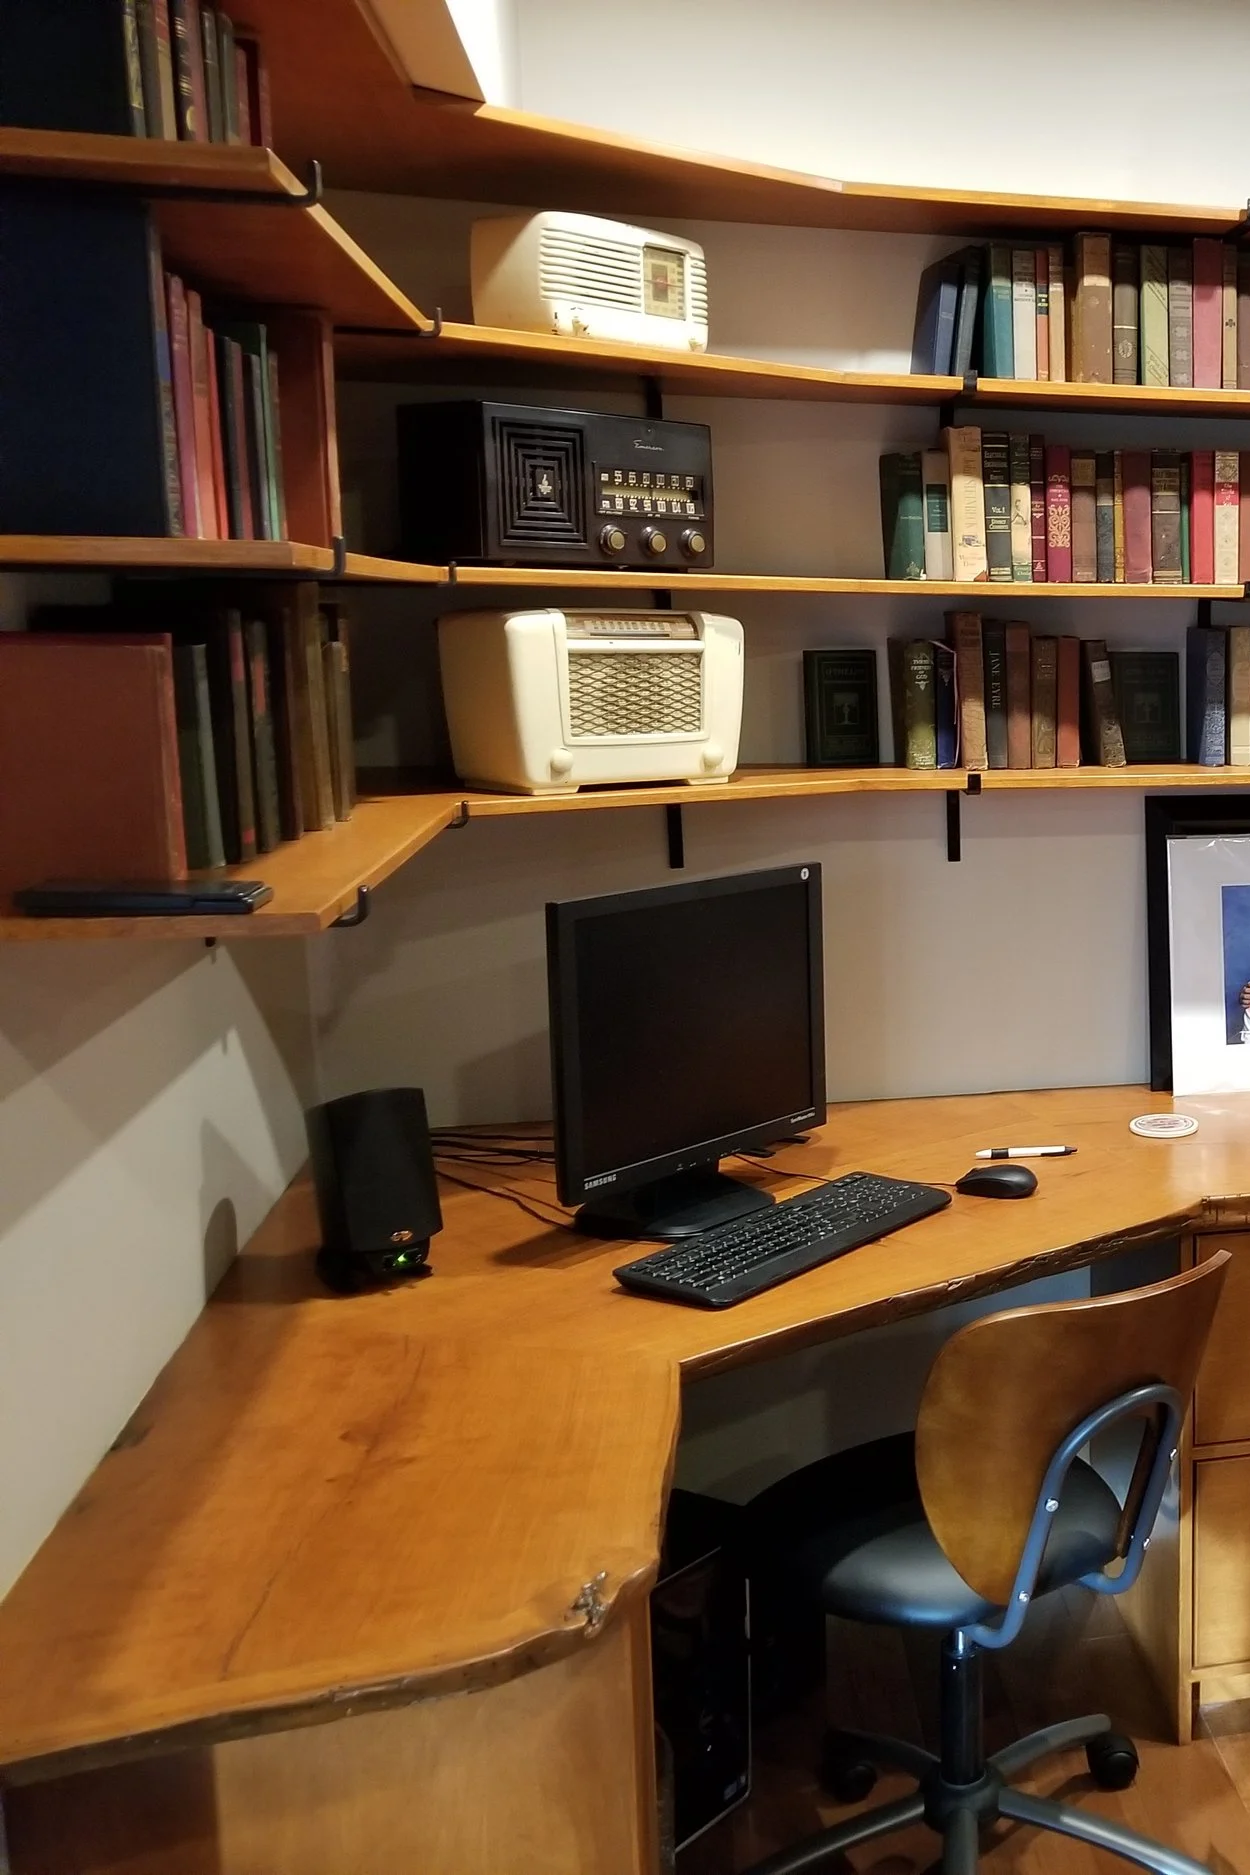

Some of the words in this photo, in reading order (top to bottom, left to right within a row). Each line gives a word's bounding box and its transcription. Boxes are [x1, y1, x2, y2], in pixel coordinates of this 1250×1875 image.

[633, 439, 664, 451] Emerson
[988, 650, 1001, 677] JANE
[991, 681, 1001, 710] EYRE
[584, 1173, 617, 1190] SAMSUNG
